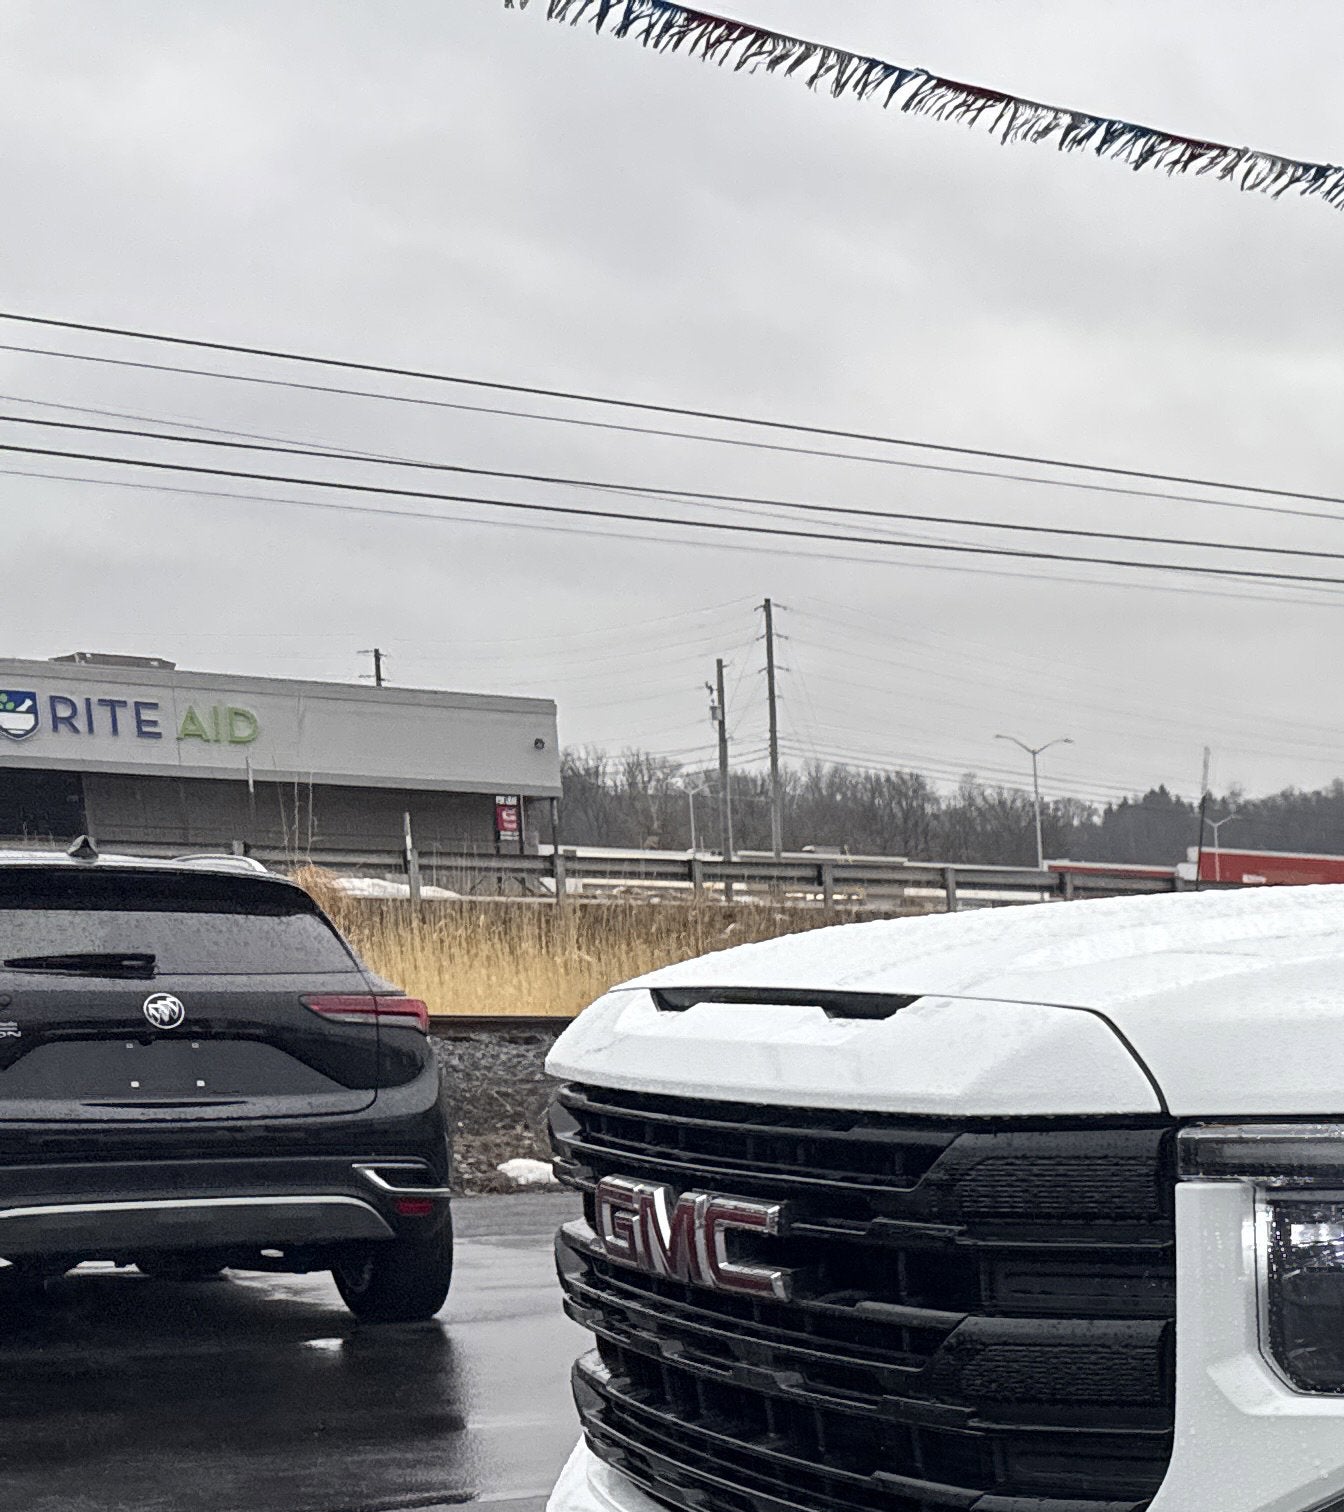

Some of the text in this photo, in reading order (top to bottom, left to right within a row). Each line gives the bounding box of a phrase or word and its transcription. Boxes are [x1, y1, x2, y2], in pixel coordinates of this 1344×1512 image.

[49, 695, 259, 743] RITE AID
[595, 1174, 790, 1301] GMC
